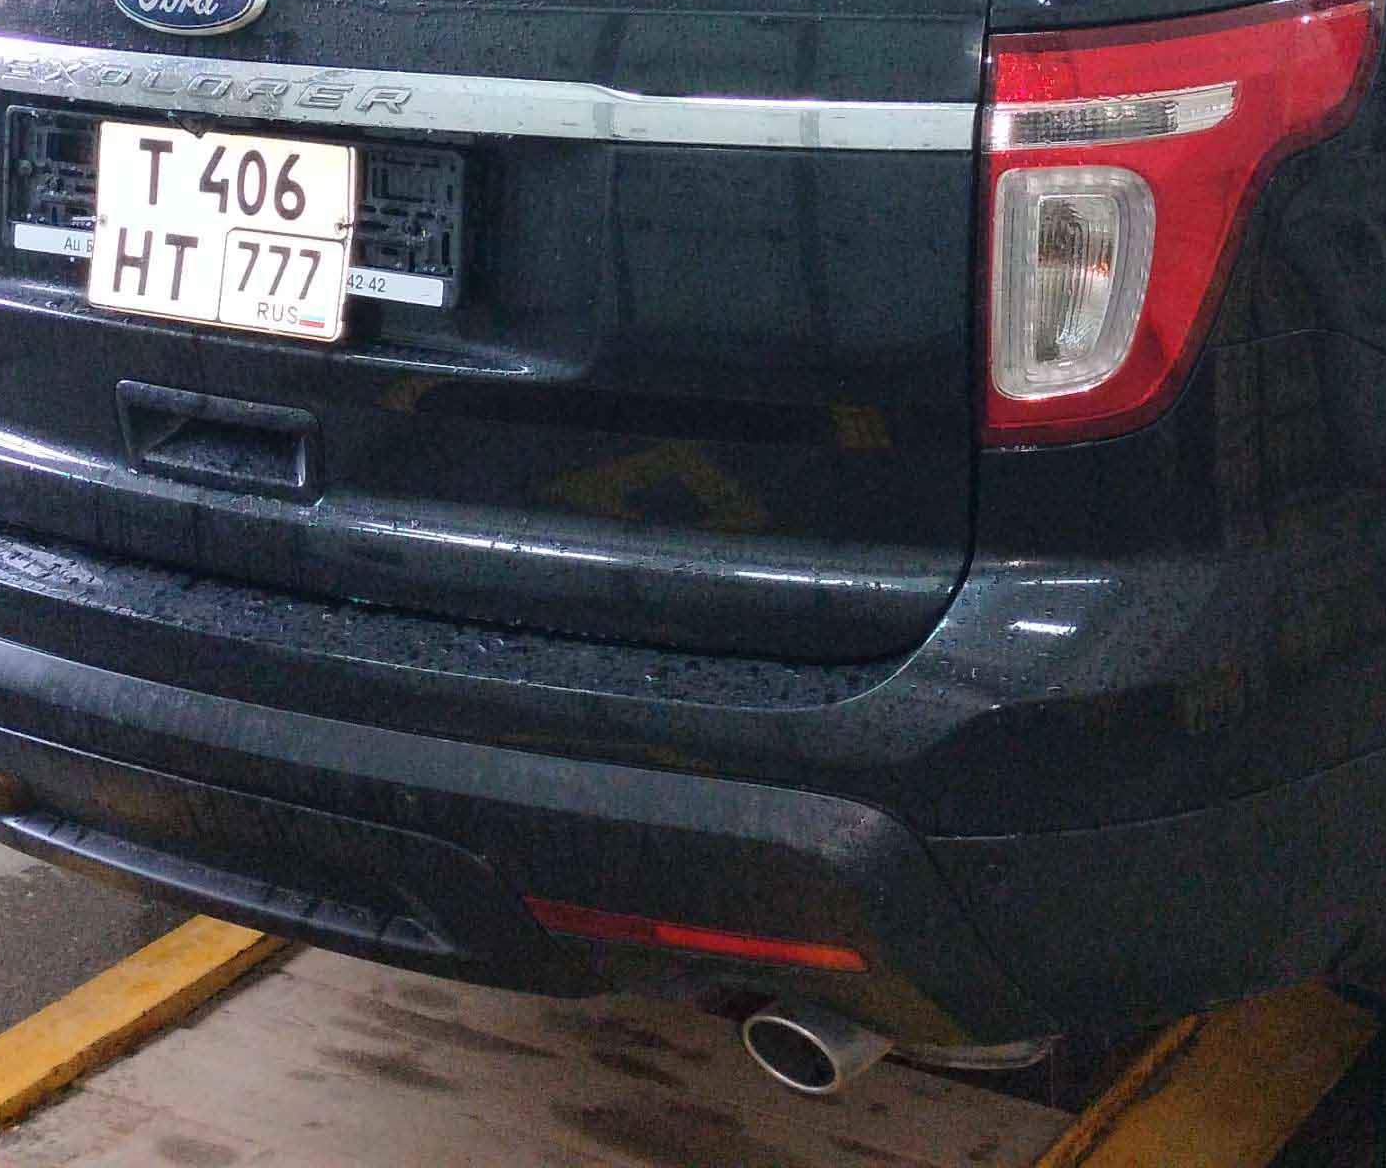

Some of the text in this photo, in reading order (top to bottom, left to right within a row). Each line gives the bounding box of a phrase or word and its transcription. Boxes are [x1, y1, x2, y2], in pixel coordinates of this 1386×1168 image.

[2, 58, 413, 115] EXPLORER
[199, 145, 307, 221] 406
[113, 227, 321, 302] НТ 777
[256, 302, 299, 324] RUS
